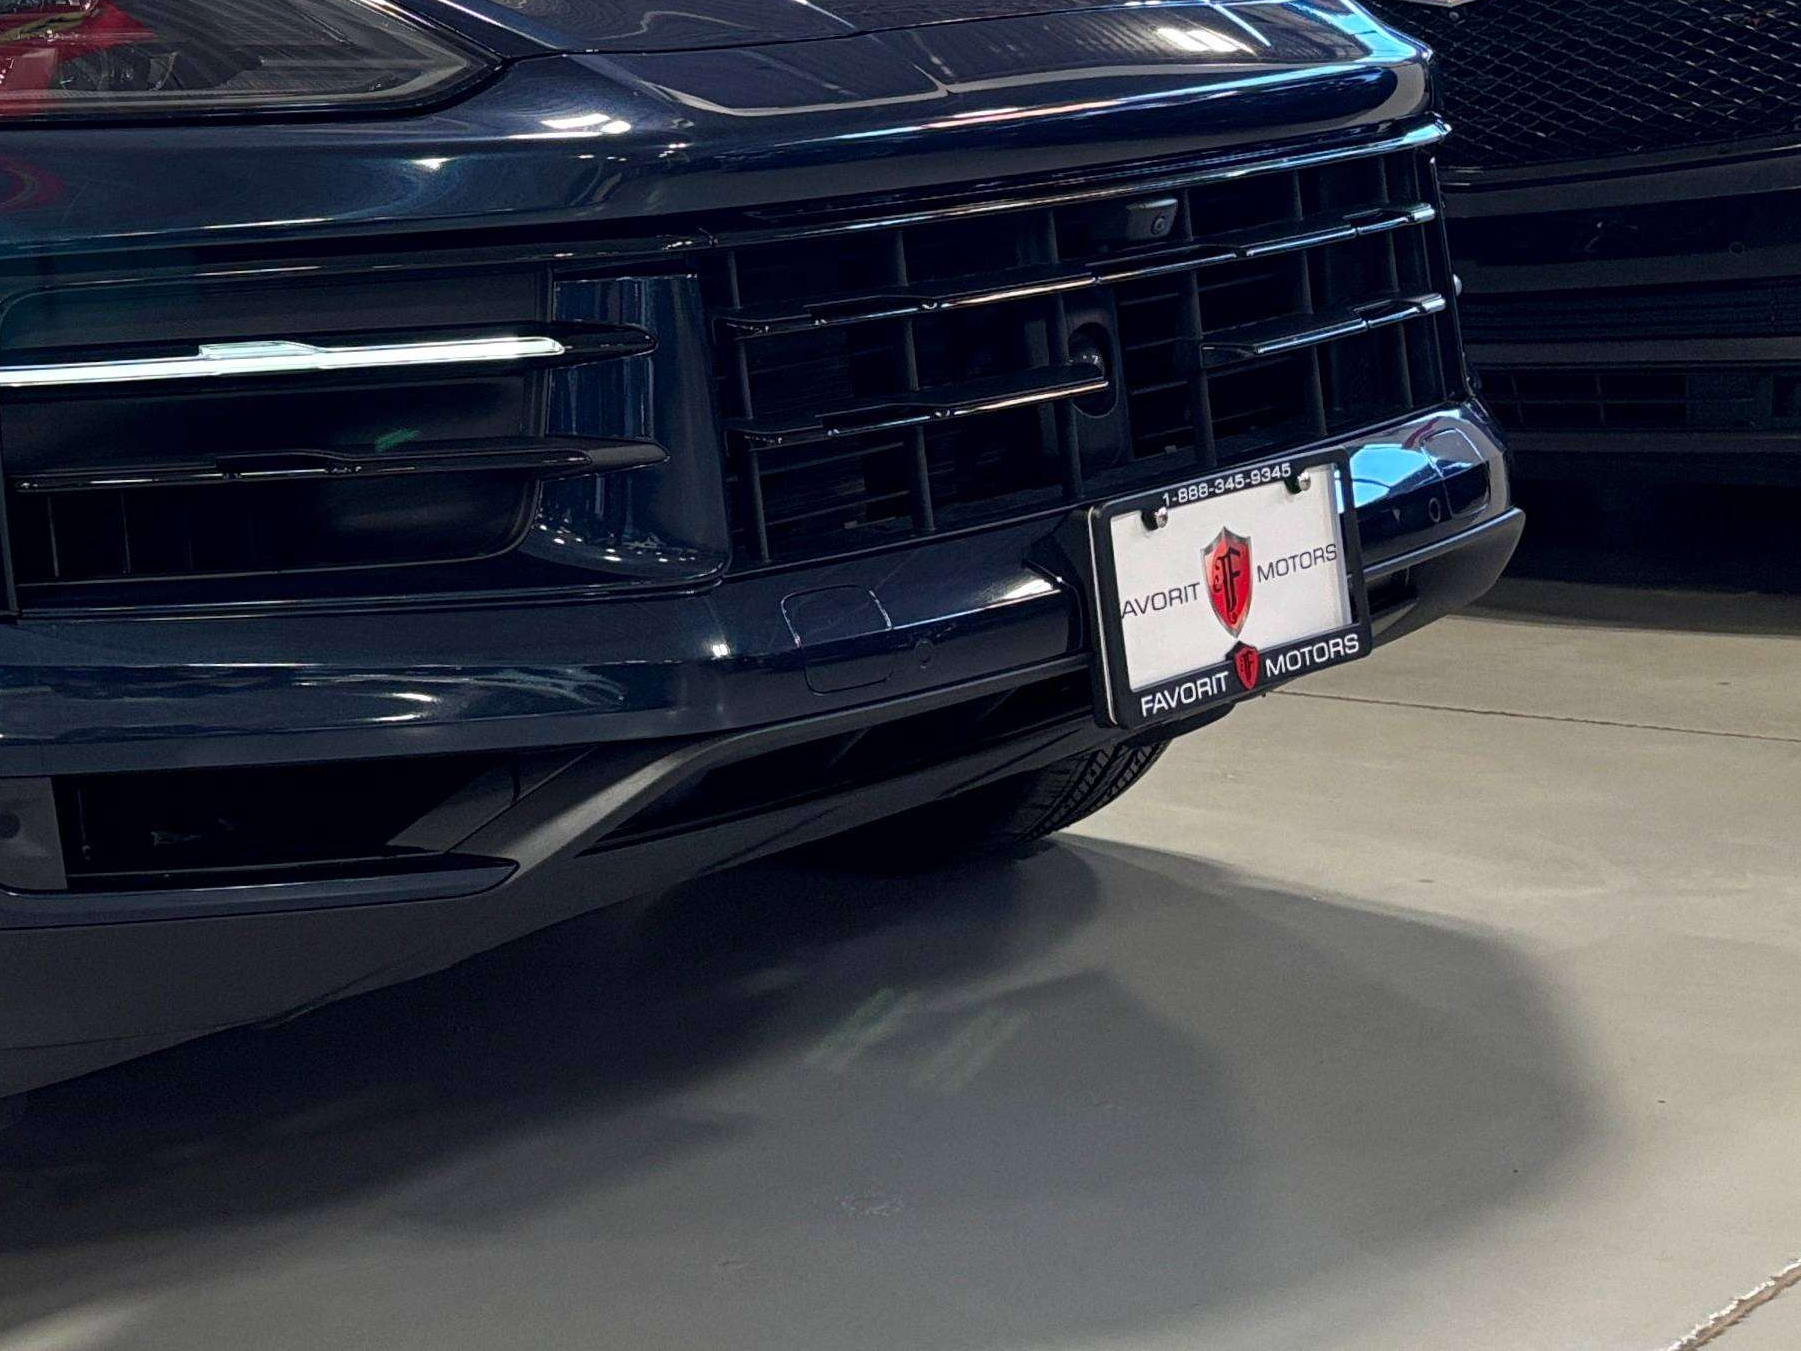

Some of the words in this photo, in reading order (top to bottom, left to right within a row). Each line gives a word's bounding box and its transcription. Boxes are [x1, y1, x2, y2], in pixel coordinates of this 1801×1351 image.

[1162, 462, 1292, 507] 1-888-345-9345
[1257, 543, 1338, 584] MOTORS
[1141, 671, 1230, 718] FAVORIT
[1265, 633, 1360, 678] MOTORS
